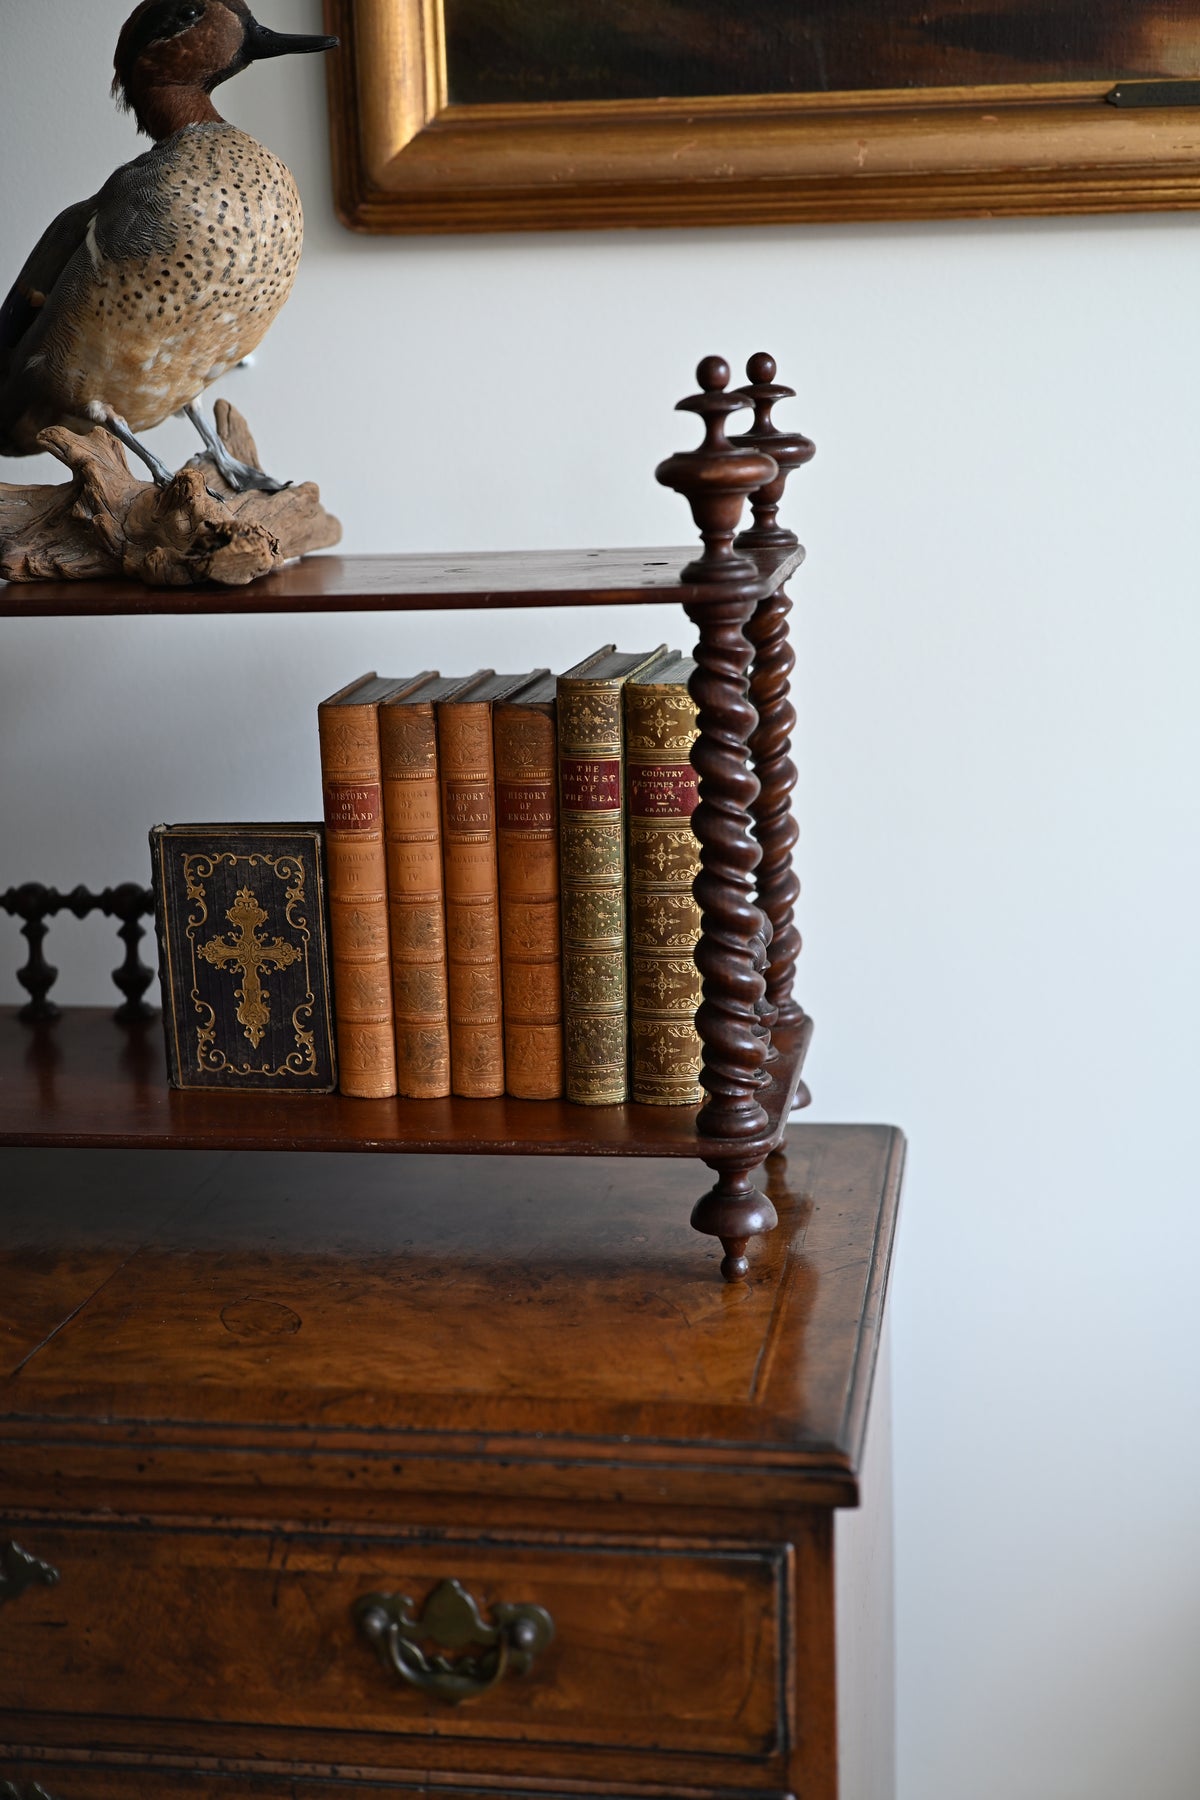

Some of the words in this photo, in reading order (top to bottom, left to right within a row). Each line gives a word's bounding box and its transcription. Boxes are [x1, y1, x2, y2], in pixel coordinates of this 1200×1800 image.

[577, 765, 600, 773] THE
[563, 774, 616, 783] HARVEST
[641, 770, 684, 778] COUNTRY
[632, 780, 674, 788] PASTIMES
[678, 780, 697, 788] FOR
[331, 791, 369, 801] HISTORY
[508, 791, 548, 800] HISTORY
[565, 794, 584, 802] THE
[591, 794, 616, 802] SEA.
[342, 803, 353, 811] OF
[520, 802, 532, 811] OF
[331, 812, 373, 821] ENGLAND
[508, 812, 552, 821] ENGLAND
